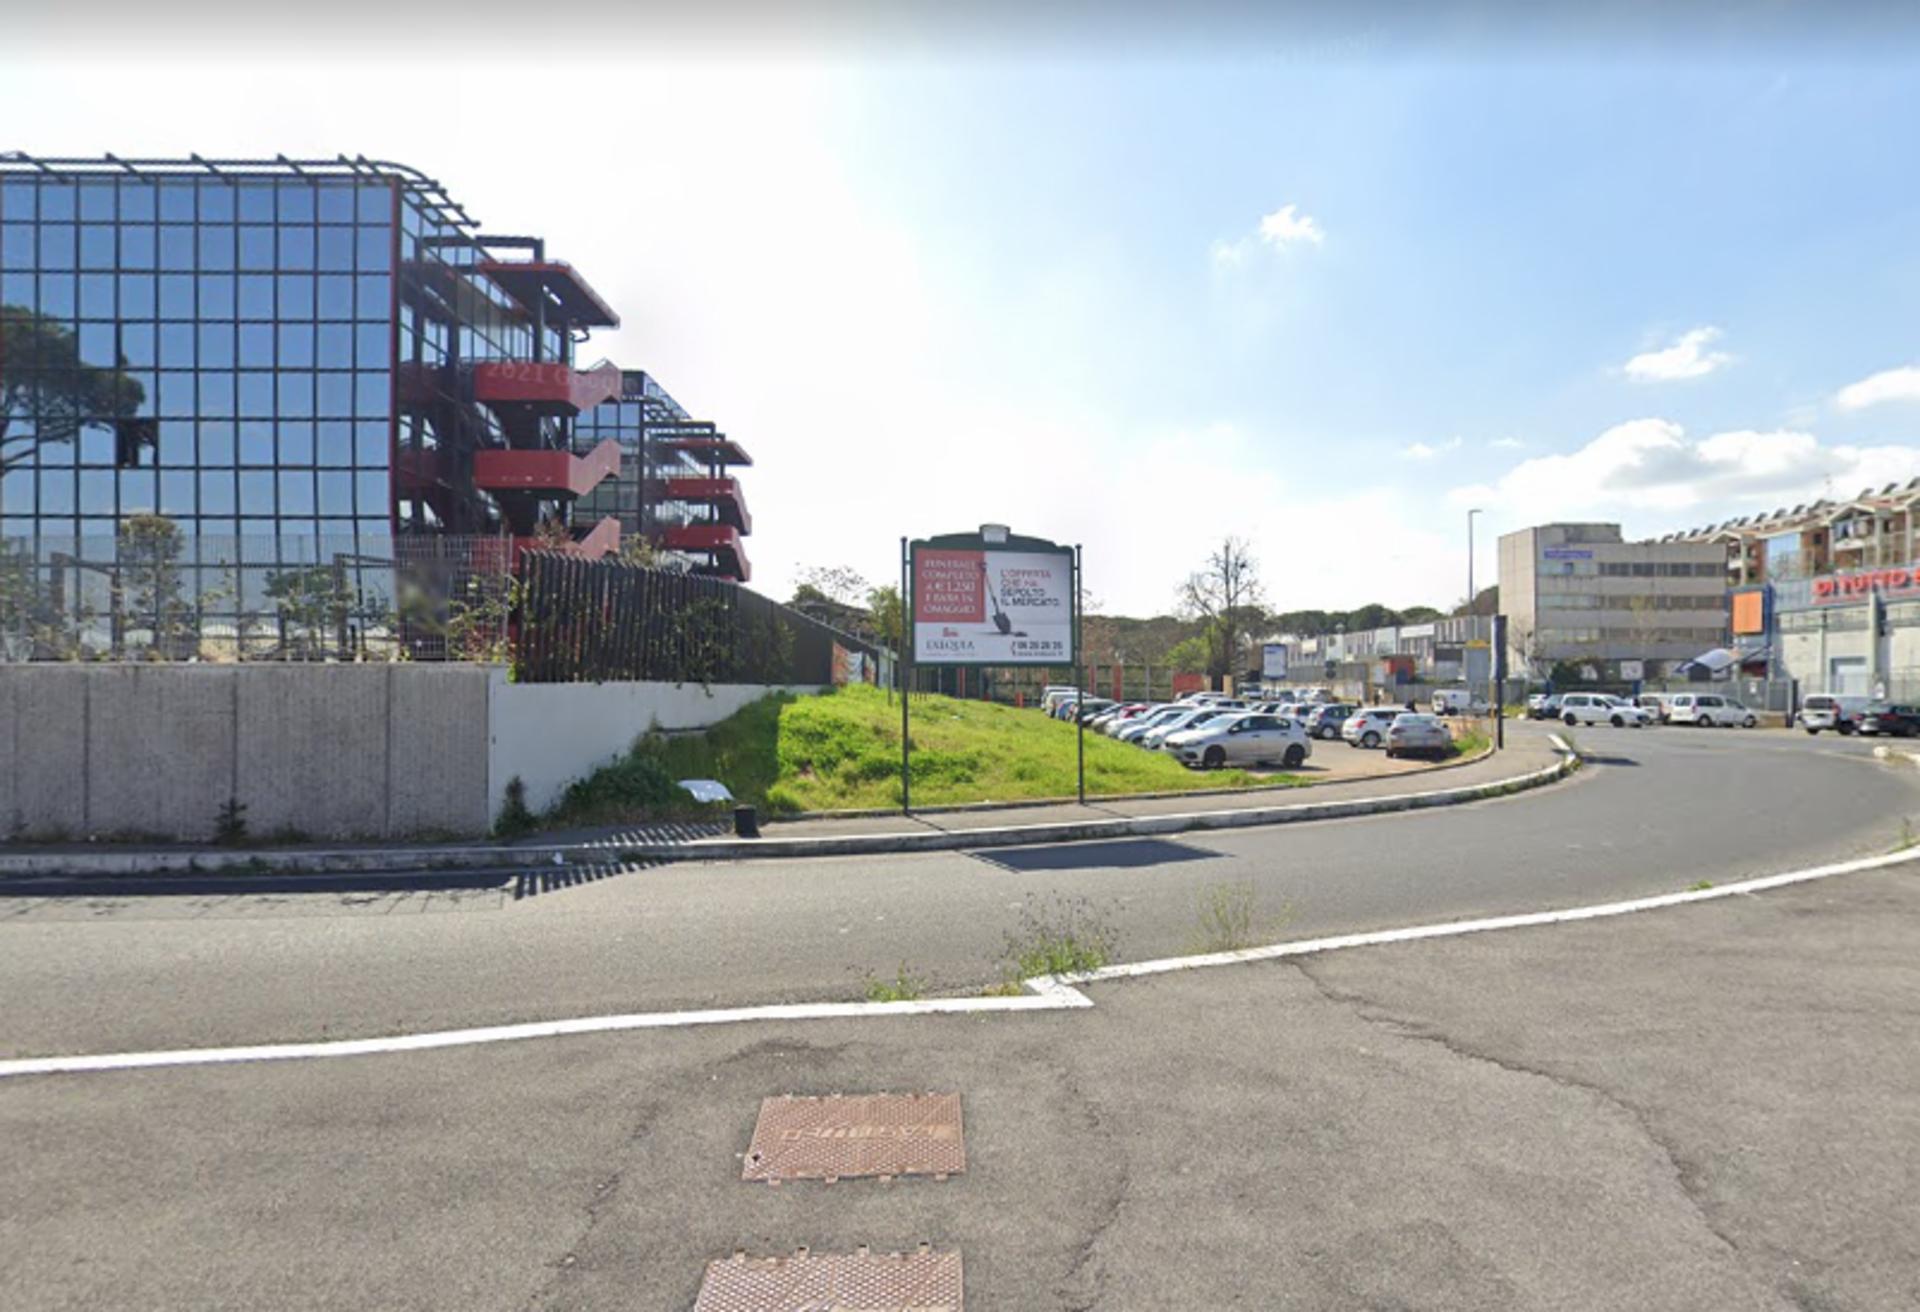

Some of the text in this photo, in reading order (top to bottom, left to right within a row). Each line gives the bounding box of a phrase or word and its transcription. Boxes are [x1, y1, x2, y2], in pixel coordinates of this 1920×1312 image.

[921, 570, 980, 581] COMPLETO
[1000, 587, 1046, 597] SEPOLTO
[1012, 597, 1060, 607] MERCATO
[922, 603, 976, 614] OMAGGIO
